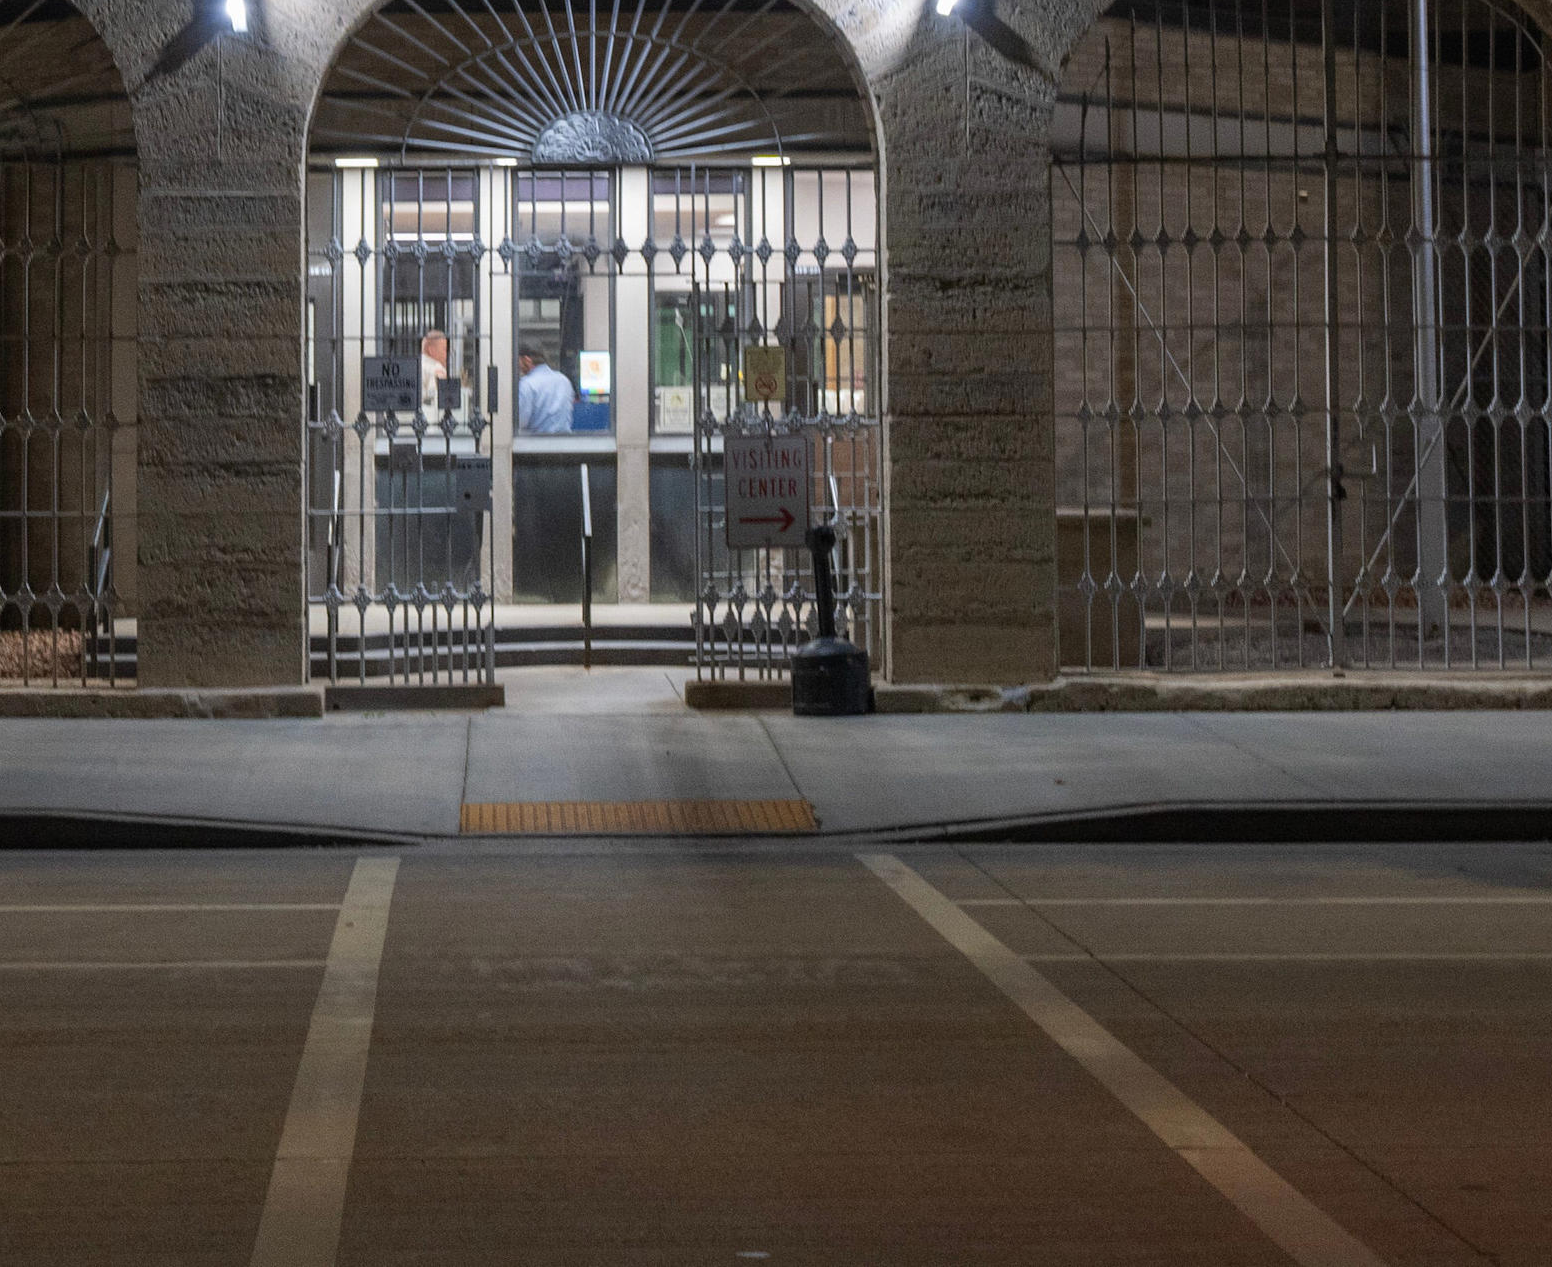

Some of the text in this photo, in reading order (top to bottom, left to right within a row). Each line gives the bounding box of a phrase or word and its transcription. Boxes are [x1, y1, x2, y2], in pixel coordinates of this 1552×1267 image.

[382, 363, 400, 377] NO
[367, 378, 415, 389] TRESPASSING
[732, 448, 802, 470] VISITING
[738, 478, 797, 499] CENTER
